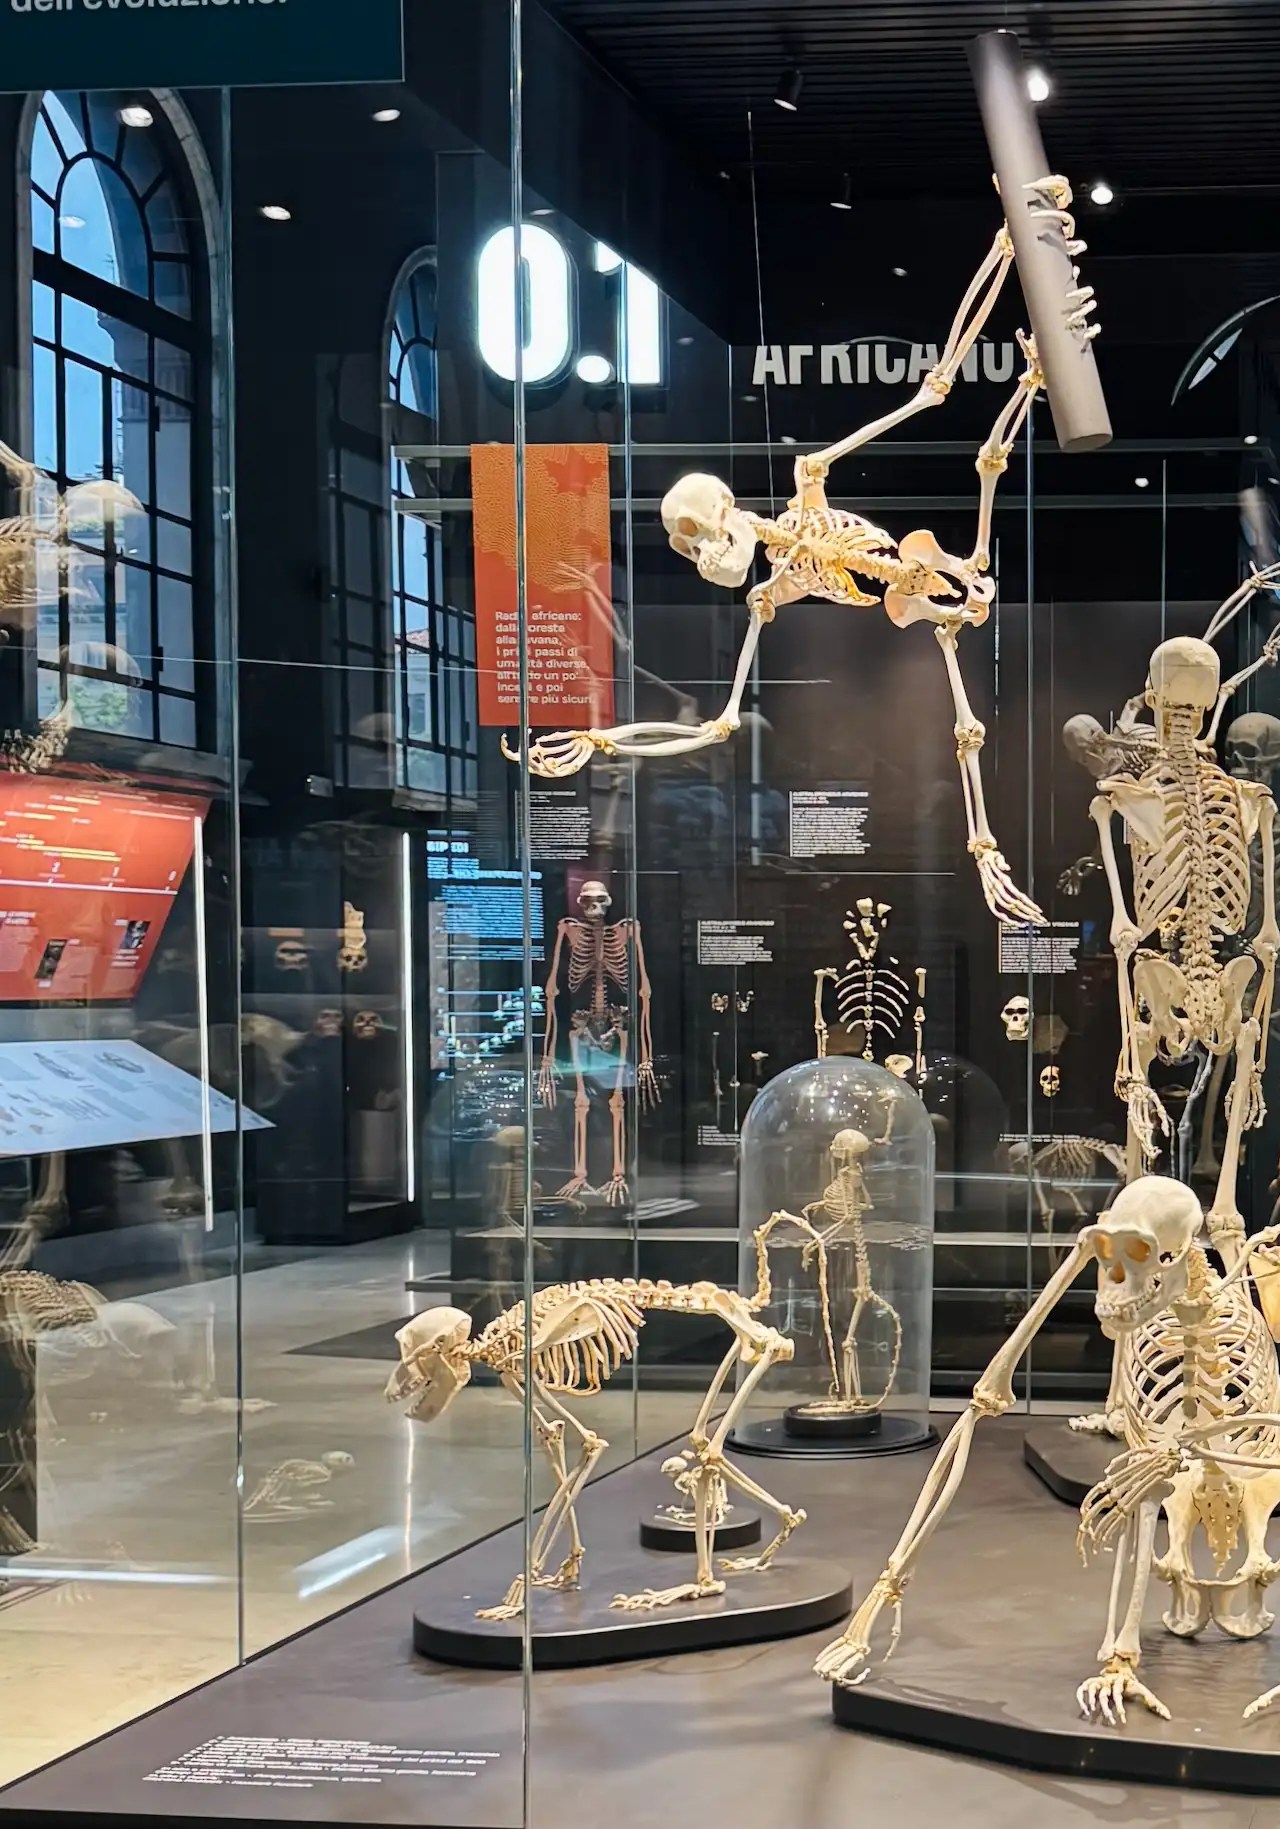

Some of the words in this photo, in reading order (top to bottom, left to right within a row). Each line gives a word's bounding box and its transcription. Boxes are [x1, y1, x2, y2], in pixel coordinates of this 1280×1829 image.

[478, 224, 660, 384] 0.1
[528, 625, 565, 633] oresta
[535, 648, 564, 657] passi
[567, 647, 578, 656] di
[544, 672, 559, 680] un
[546, 683, 564, 694] poi
[541, 693, 559, 705] più
